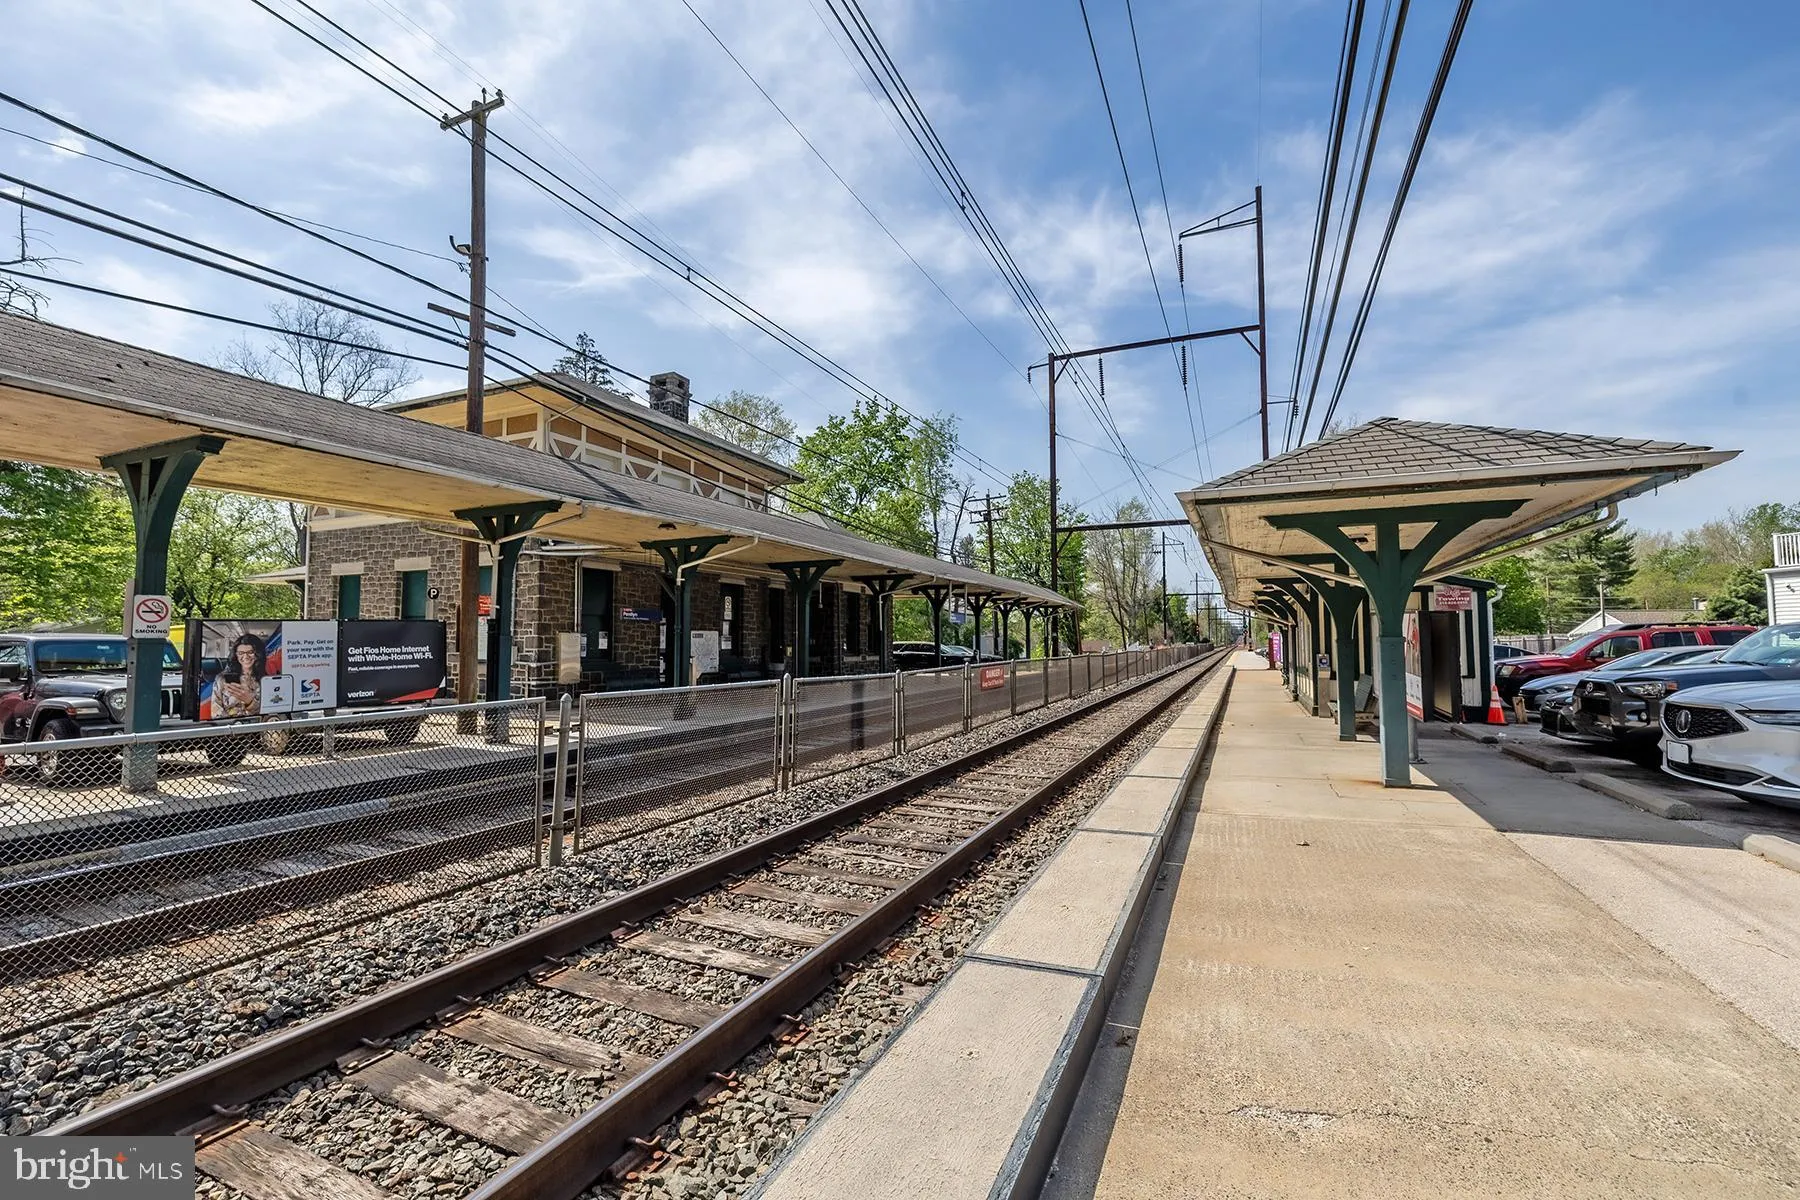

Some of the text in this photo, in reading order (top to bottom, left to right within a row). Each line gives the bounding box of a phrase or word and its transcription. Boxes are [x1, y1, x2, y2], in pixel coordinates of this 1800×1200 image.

[430, 588, 438, 598] P
[348, 645, 430, 655] Get Fios Home Internet
[347, 690, 374, 698] verizon
